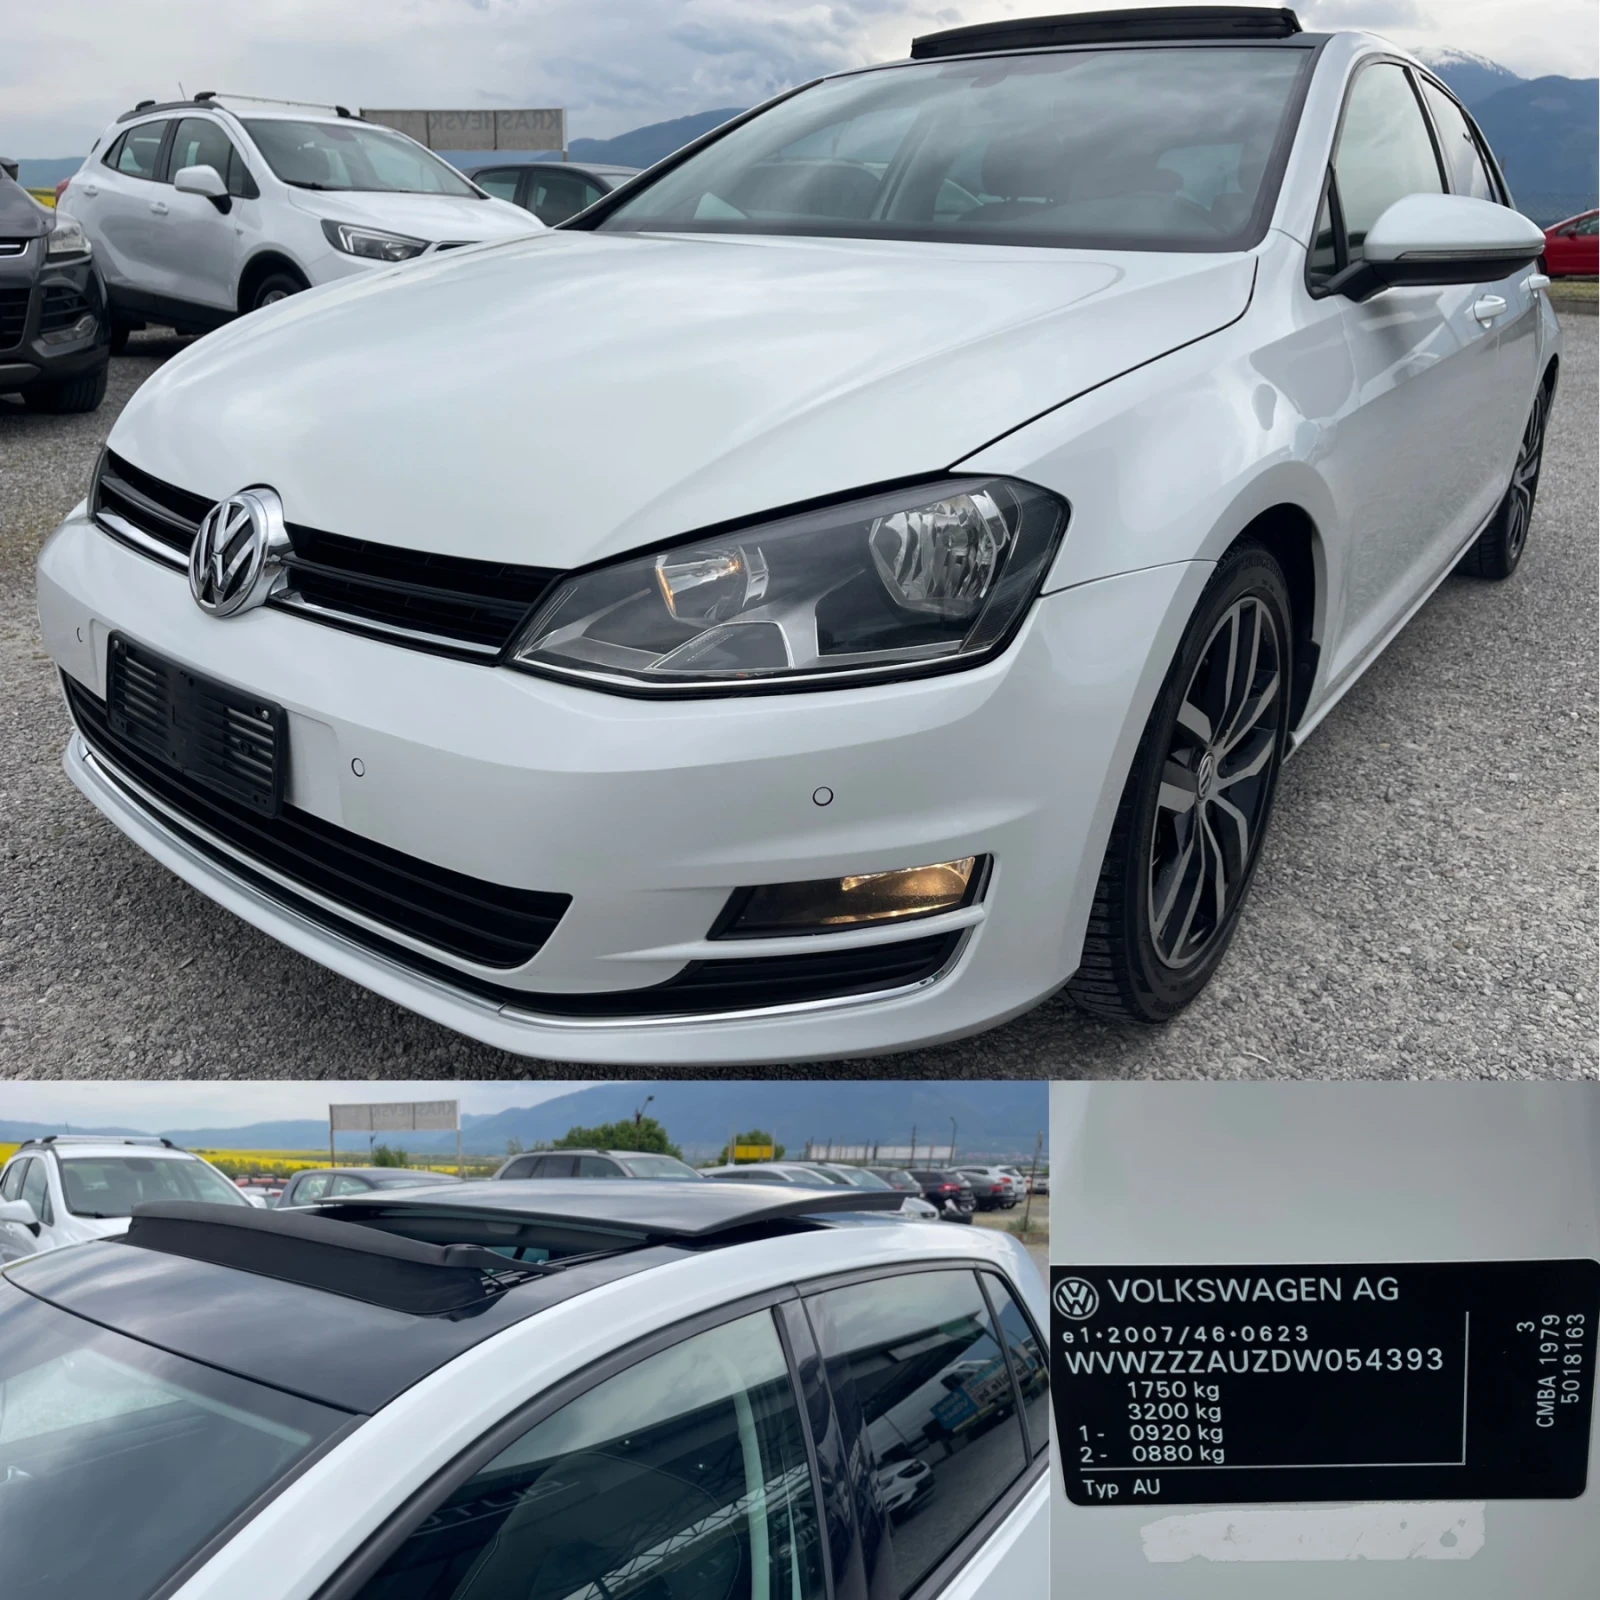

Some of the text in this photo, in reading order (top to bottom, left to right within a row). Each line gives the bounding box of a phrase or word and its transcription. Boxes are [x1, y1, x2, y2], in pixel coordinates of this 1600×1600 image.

[1107, 1276, 1399, 1303] VOLKSWAGEN AG
[1516, 1321, 1536, 1332] 3
[1065, 1347, 1444, 1375] WVWZZZAUZDW054393
[1560, 1313, 1586, 1404] 5018163
[1536, 1314, 1561, 1428] CMBA 1979
[1127, 1380, 1220, 1402] 1750 kg
[1127, 1402, 1222, 1423] 3200 kg
[1129, 1423, 1192, 1441] 0920
[1197, 1424, 1224, 1444] kg
[1132, 1444, 1193, 1462] 0880
[1199, 1445, 1225, 1465] kg
[1082, 1478, 1161, 1499] Typ AU
